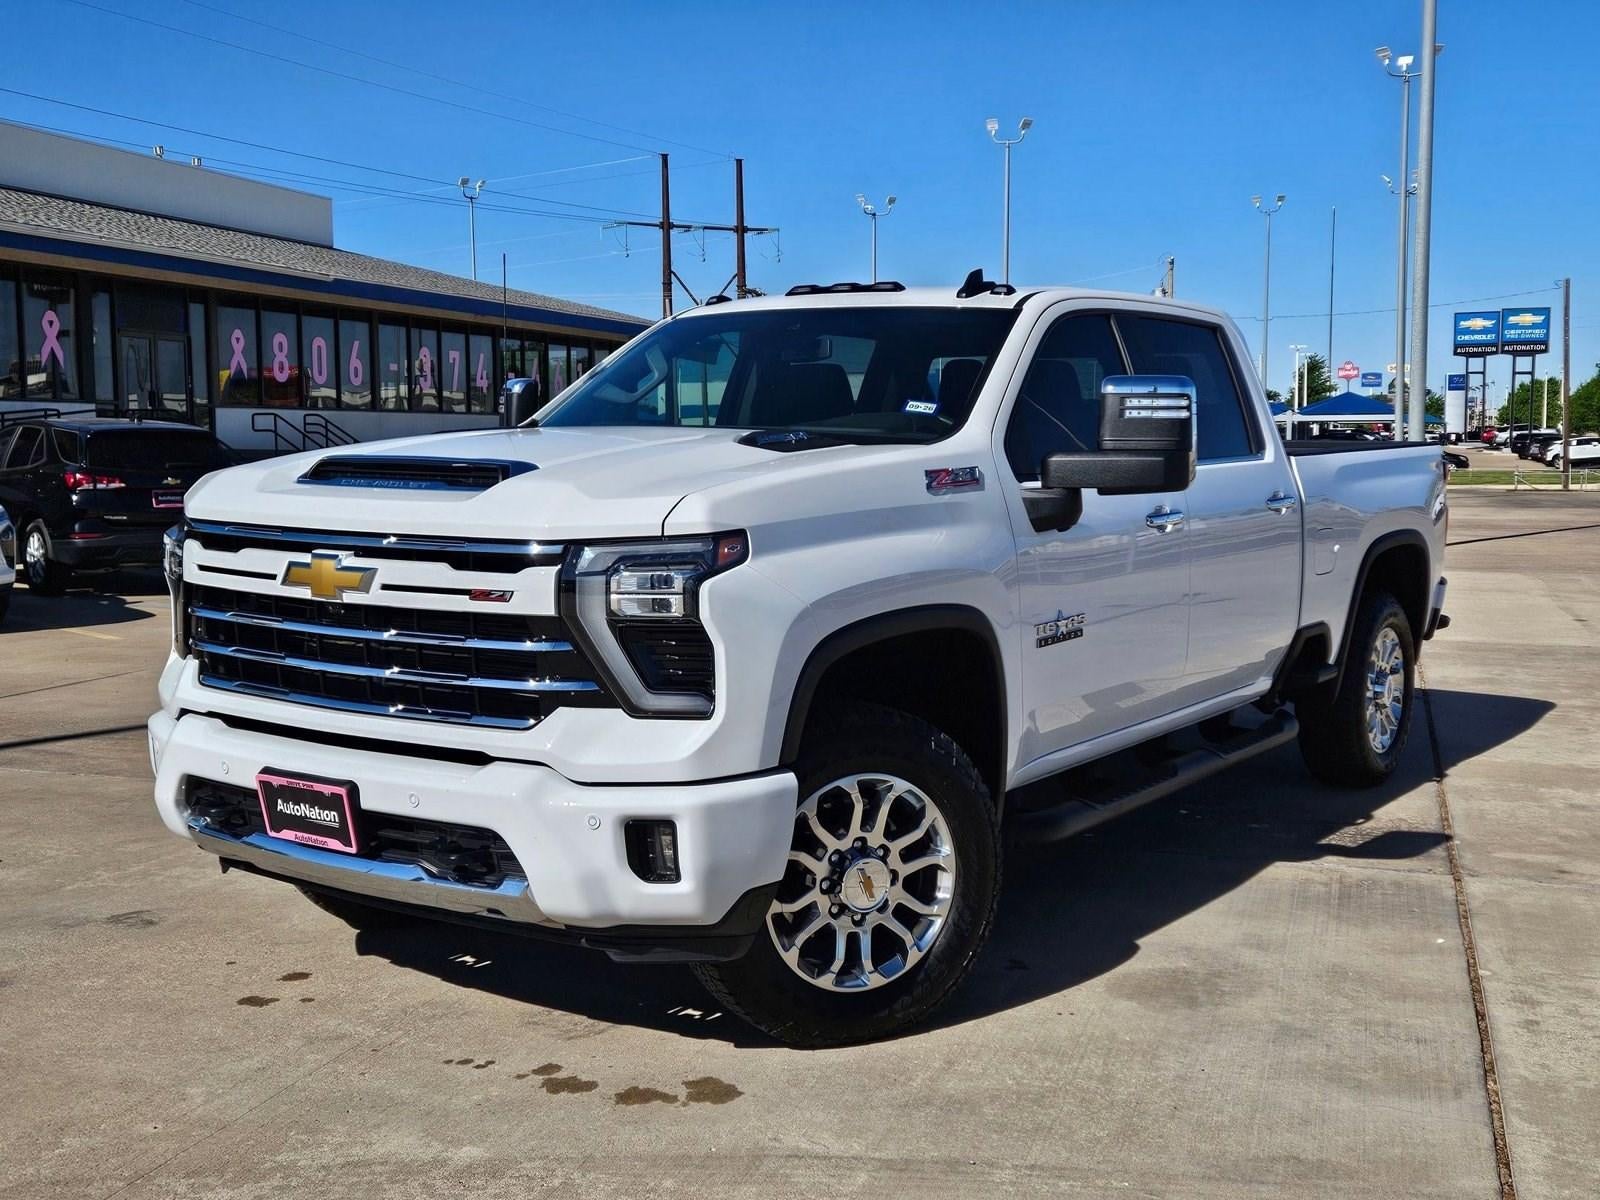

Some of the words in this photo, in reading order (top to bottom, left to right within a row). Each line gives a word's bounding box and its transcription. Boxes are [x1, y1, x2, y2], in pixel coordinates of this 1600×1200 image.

[1457, 333, 1496, 341] CHEVROLET
[925, 466, 979, 489] Z71
[277, 798, 339, 822] AutoNation
[294, 833, 329, 847] AutoNation
